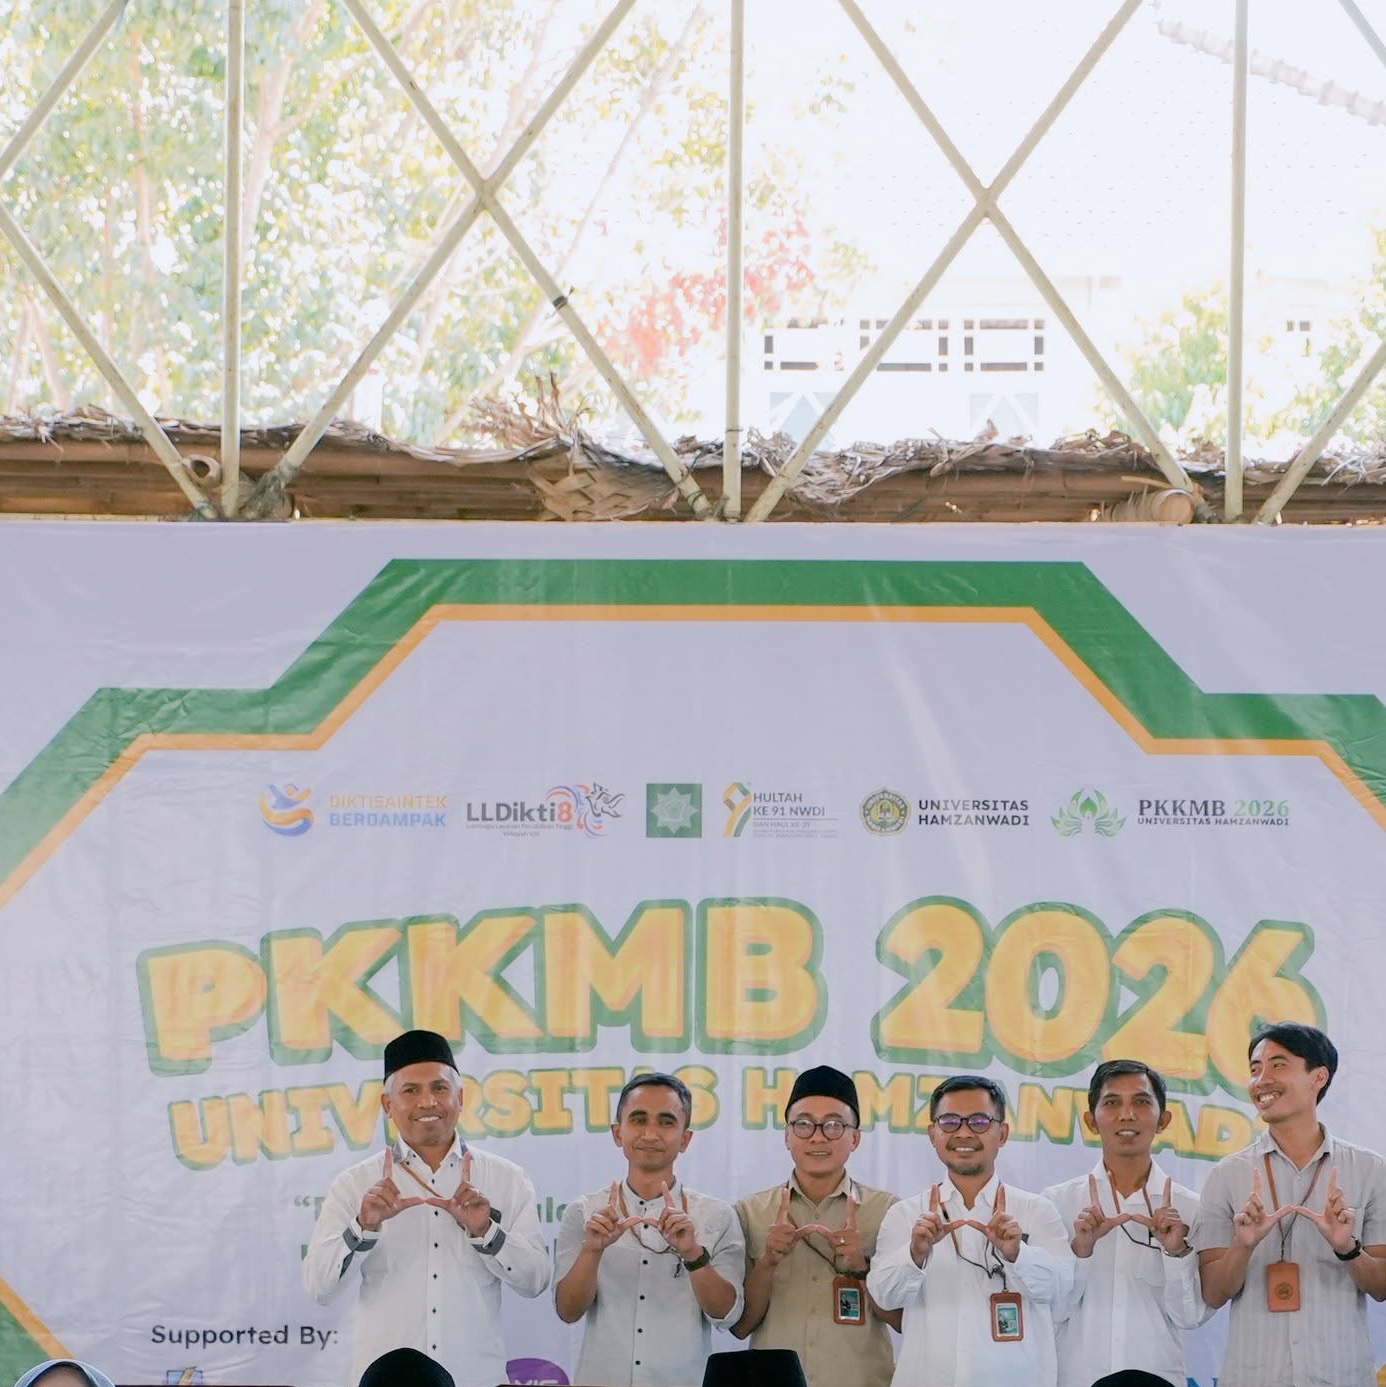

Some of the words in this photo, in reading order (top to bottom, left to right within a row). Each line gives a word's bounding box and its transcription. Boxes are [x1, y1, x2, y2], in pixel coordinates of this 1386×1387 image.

[329, 794, 447, 809] DIKTISAINTEK
[753, 792, 803, 803] HULTAH
[918, 799, 1029, 811] UNIVERSITAS
[466, 801, 573, 822] LLDikti8
[753, 806, 769, 816] KE
[772, 806, 786, 816] 91
[789, 806, 825, 817] NWDI
[1139, 799, 1226, 817] PKKMB
[1234, 800, 1290, 817] 2026
[329, 812, 446, 827] BERDAMPAK
[918, 814, 1030, 826] HAMZANWADI
[1137, 817, 1212, 826] UNIVERSITAS
[1215, 818, 1290, 826] HAMZANWADI
[136, 898, 828, 1077] PKKMB
[870, 895, 1326, 1100] 2026
[168, 1065, 719, 1170] UNIVRSITS
[151, 1325, 289, 1350] Supported
[300, 1326, 338, 1350] By:
